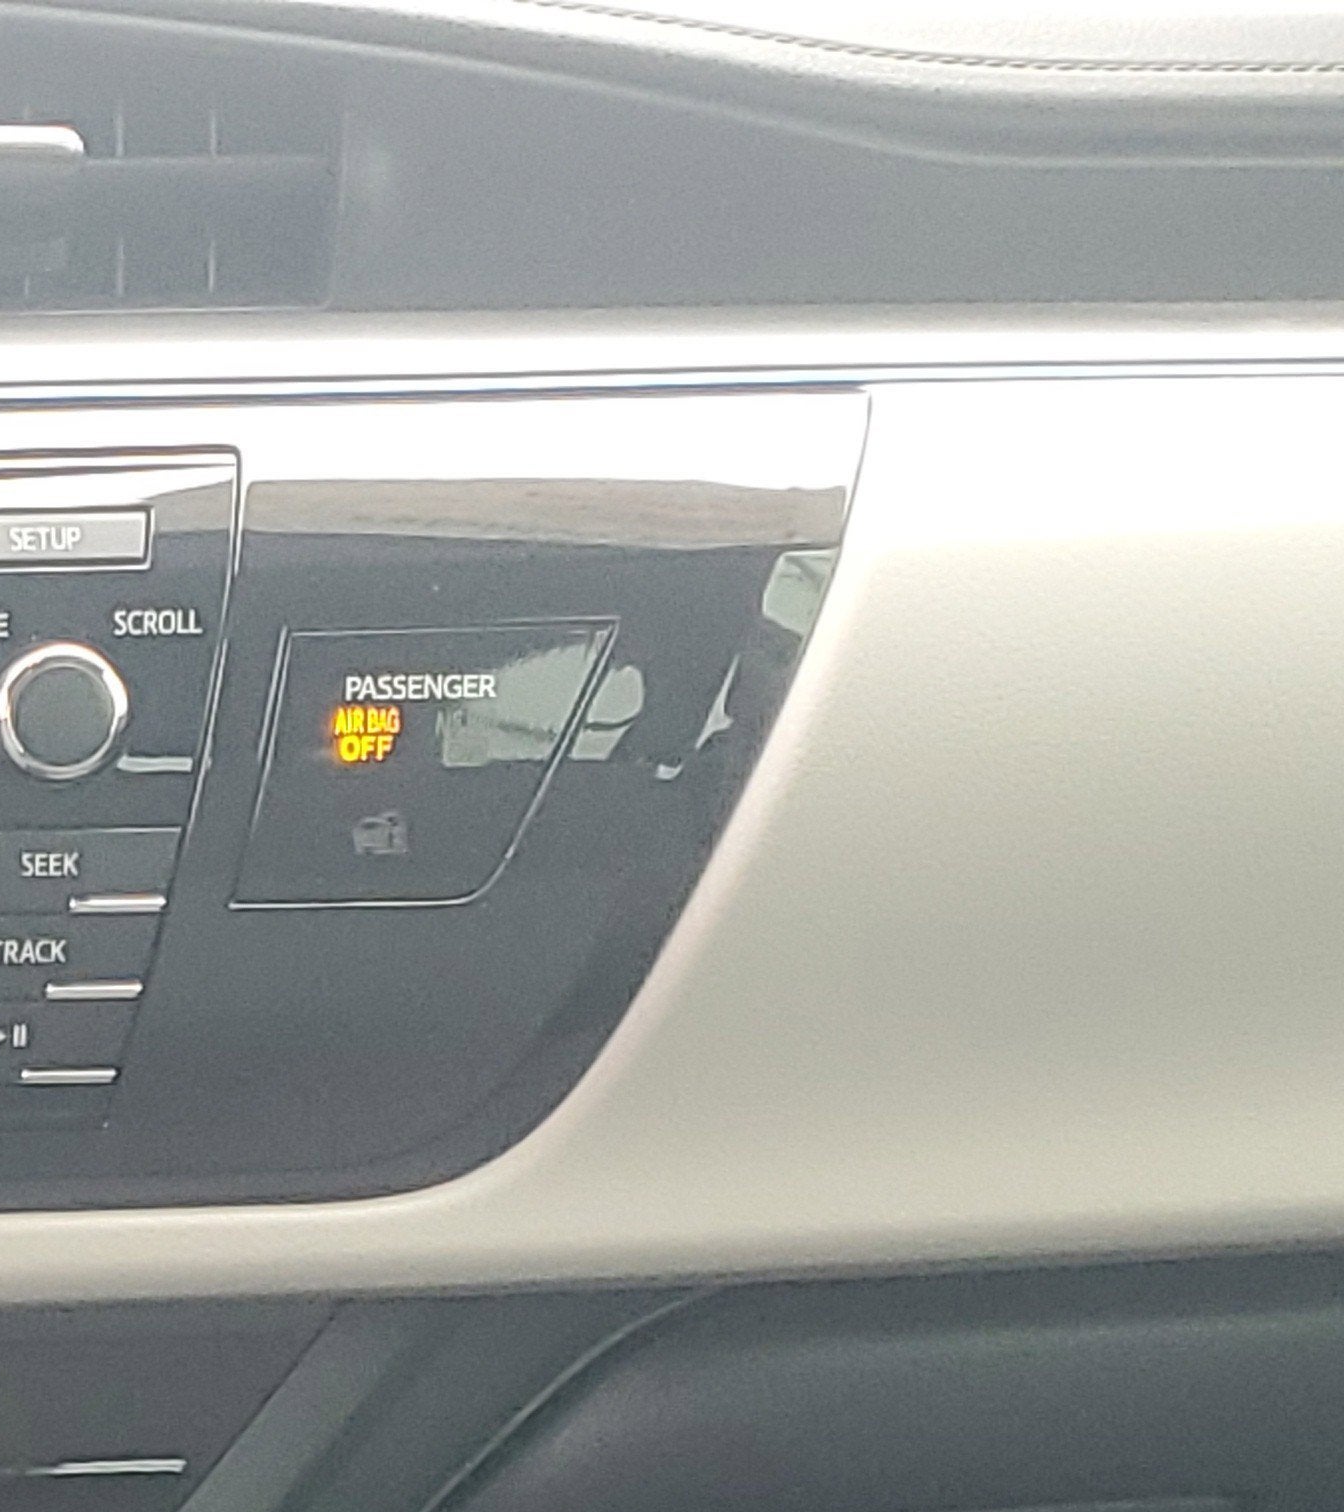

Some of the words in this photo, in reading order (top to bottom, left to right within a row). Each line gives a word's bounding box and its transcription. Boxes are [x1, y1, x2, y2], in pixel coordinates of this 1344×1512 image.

[9, 527, 81, 551] SETUP
[113, 609, 203, 636] SCROLL
[345, 674, 498, 701] PASSENGER
[335, 708, 364, 735] AIR
[367, 708, 400, 735] BAG
[340, 736, 392, 761] OFF
[21, 852, 79, 877] SEEK
